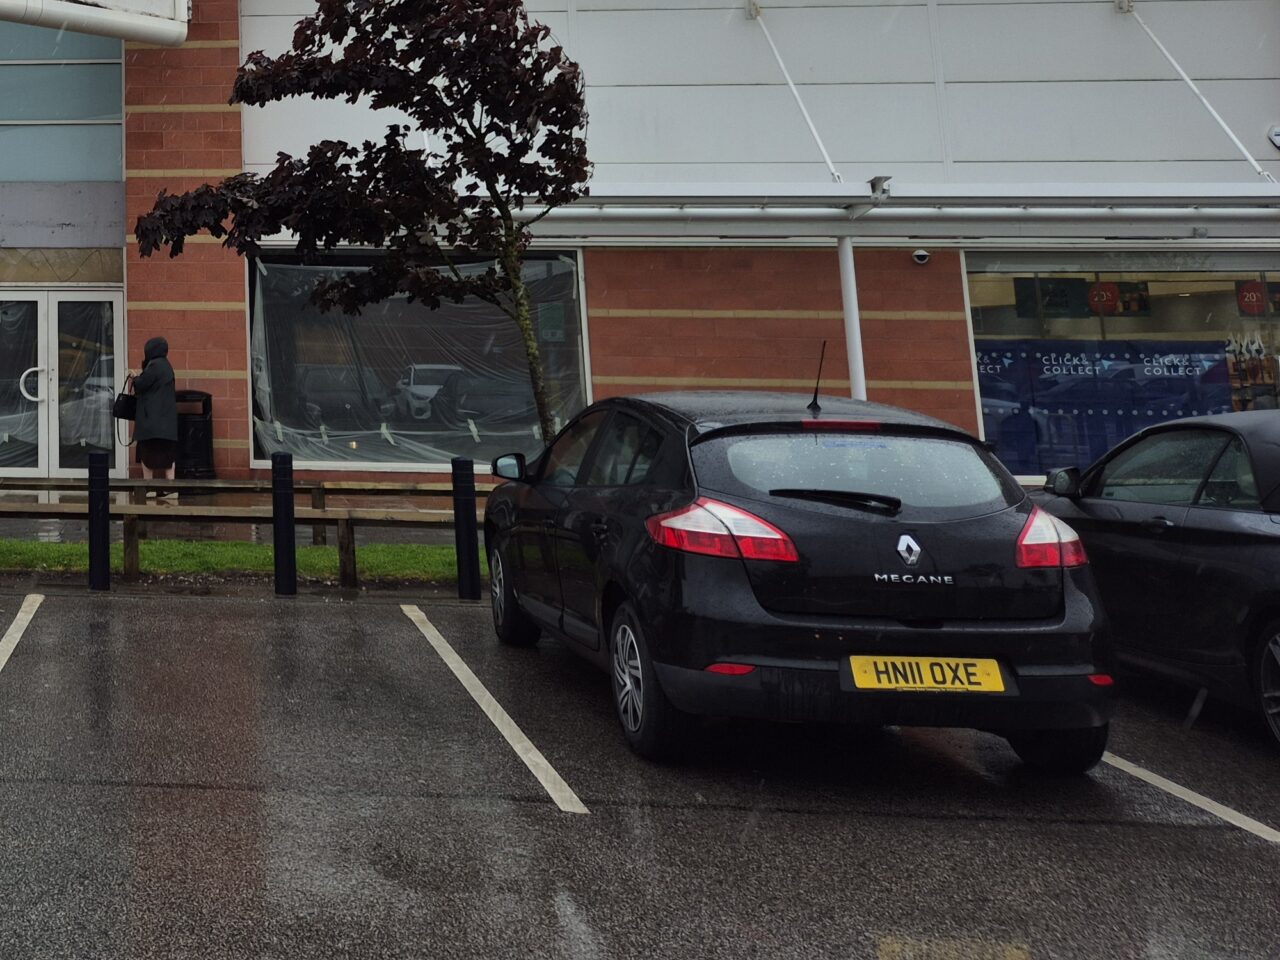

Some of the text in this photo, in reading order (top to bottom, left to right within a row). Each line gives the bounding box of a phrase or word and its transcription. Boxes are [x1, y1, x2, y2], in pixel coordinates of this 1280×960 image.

[1043, 366, 1101, 375] COLLECT
[1144, 367, 1202, 376] COLLECT
[874, 573, 954, 585] MEGANE
[873, 661, 982, 686] HN11 OXE
